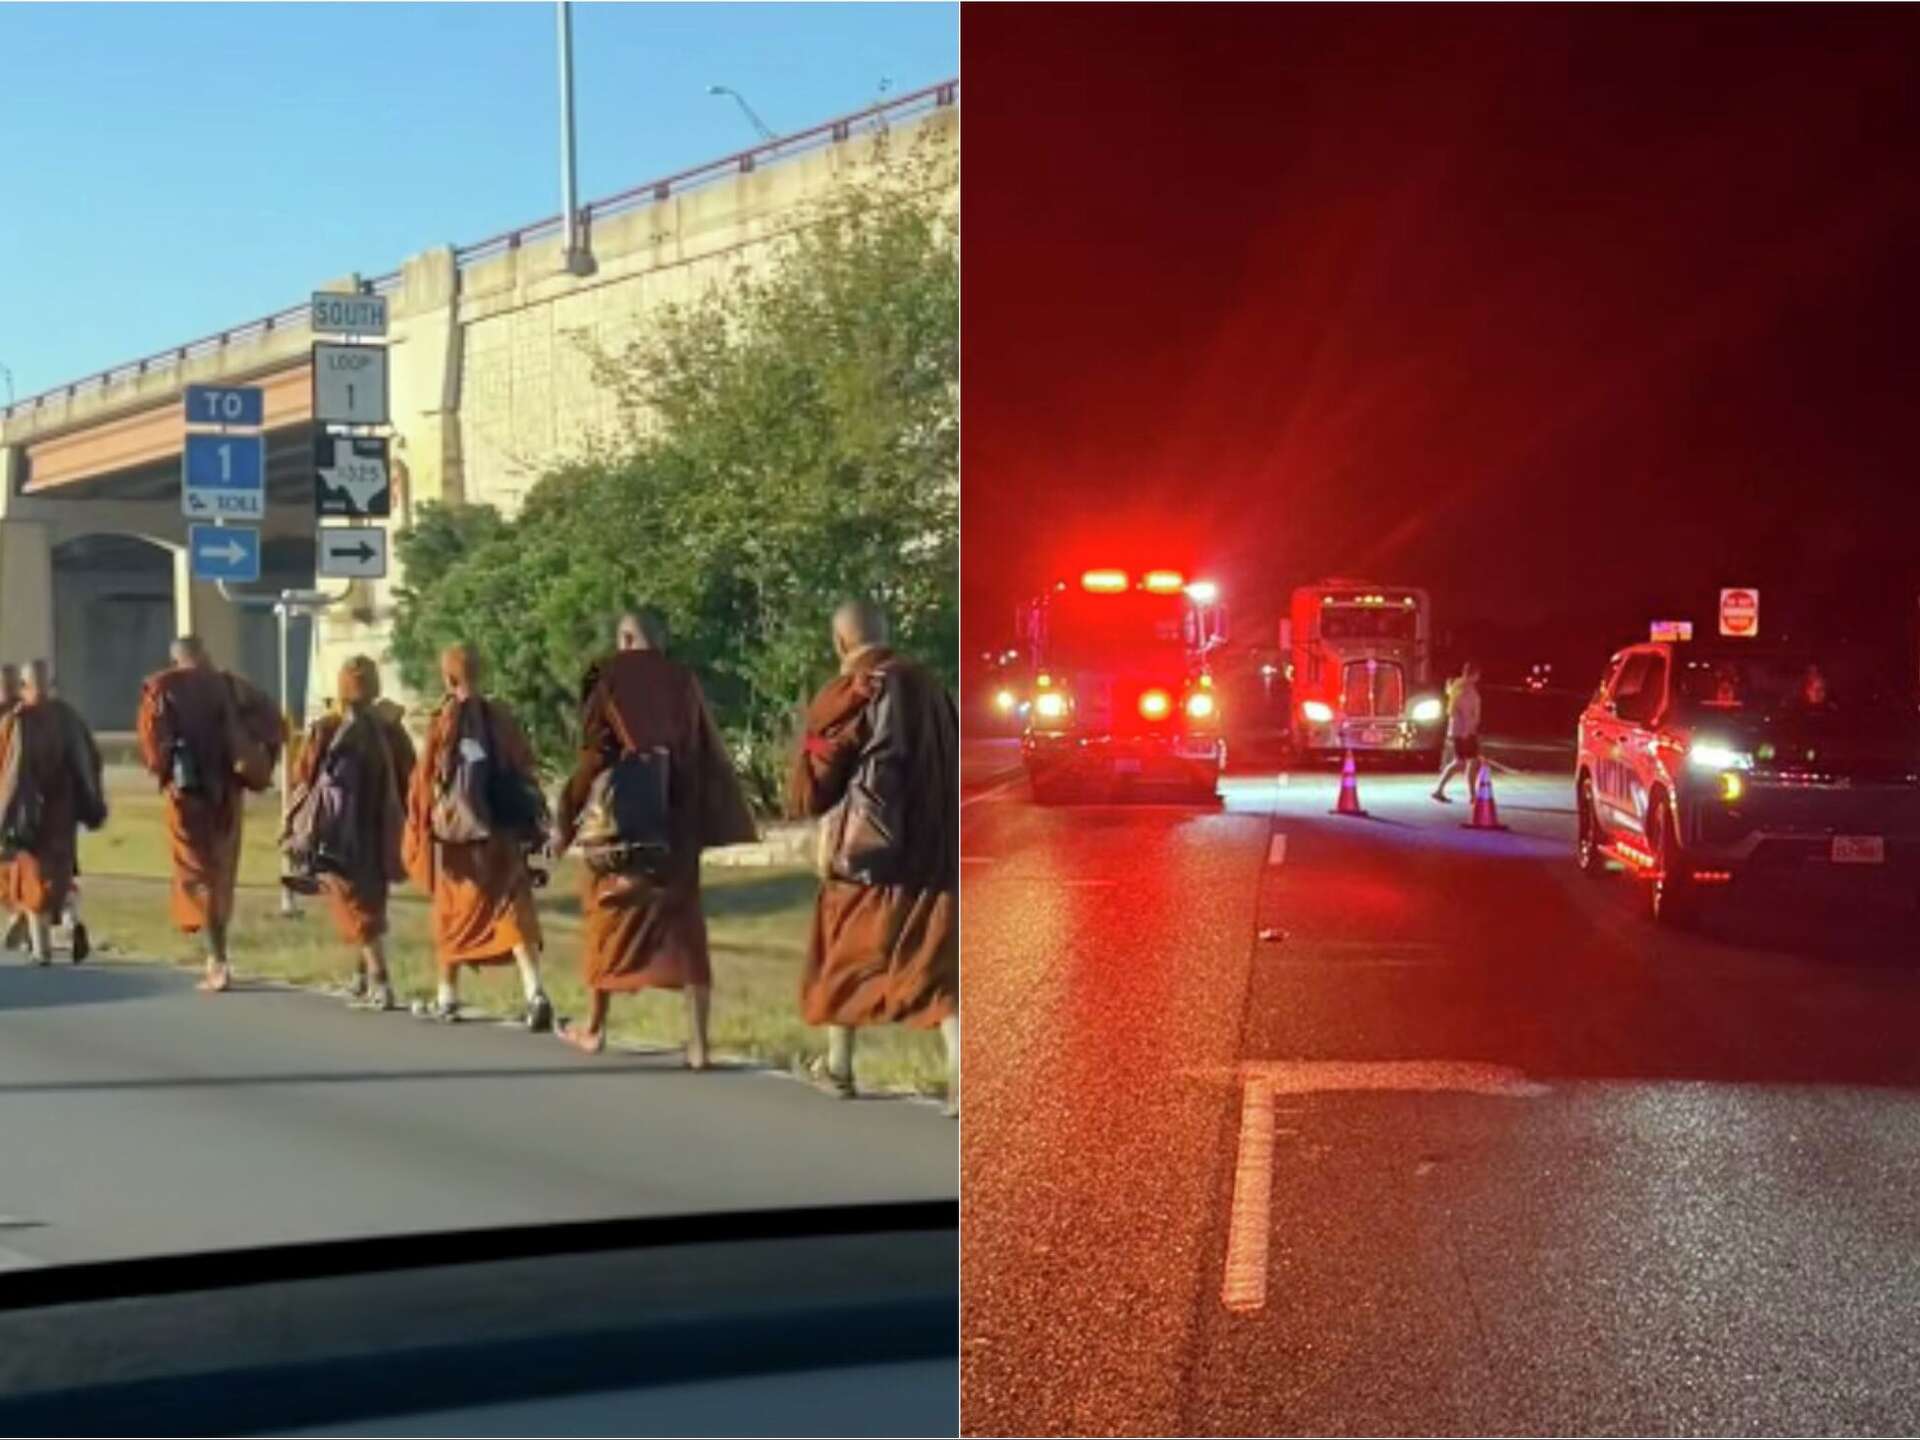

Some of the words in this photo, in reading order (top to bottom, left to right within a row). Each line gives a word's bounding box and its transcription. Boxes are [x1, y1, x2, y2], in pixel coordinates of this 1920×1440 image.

[315, 301, 383, 326] SOUTH
[328, 355, 371, 370] LOOP
[204, 391, 242, 418] TO
[346, 384, 354, 410] 1
[217, 444, 230, 481] 1
